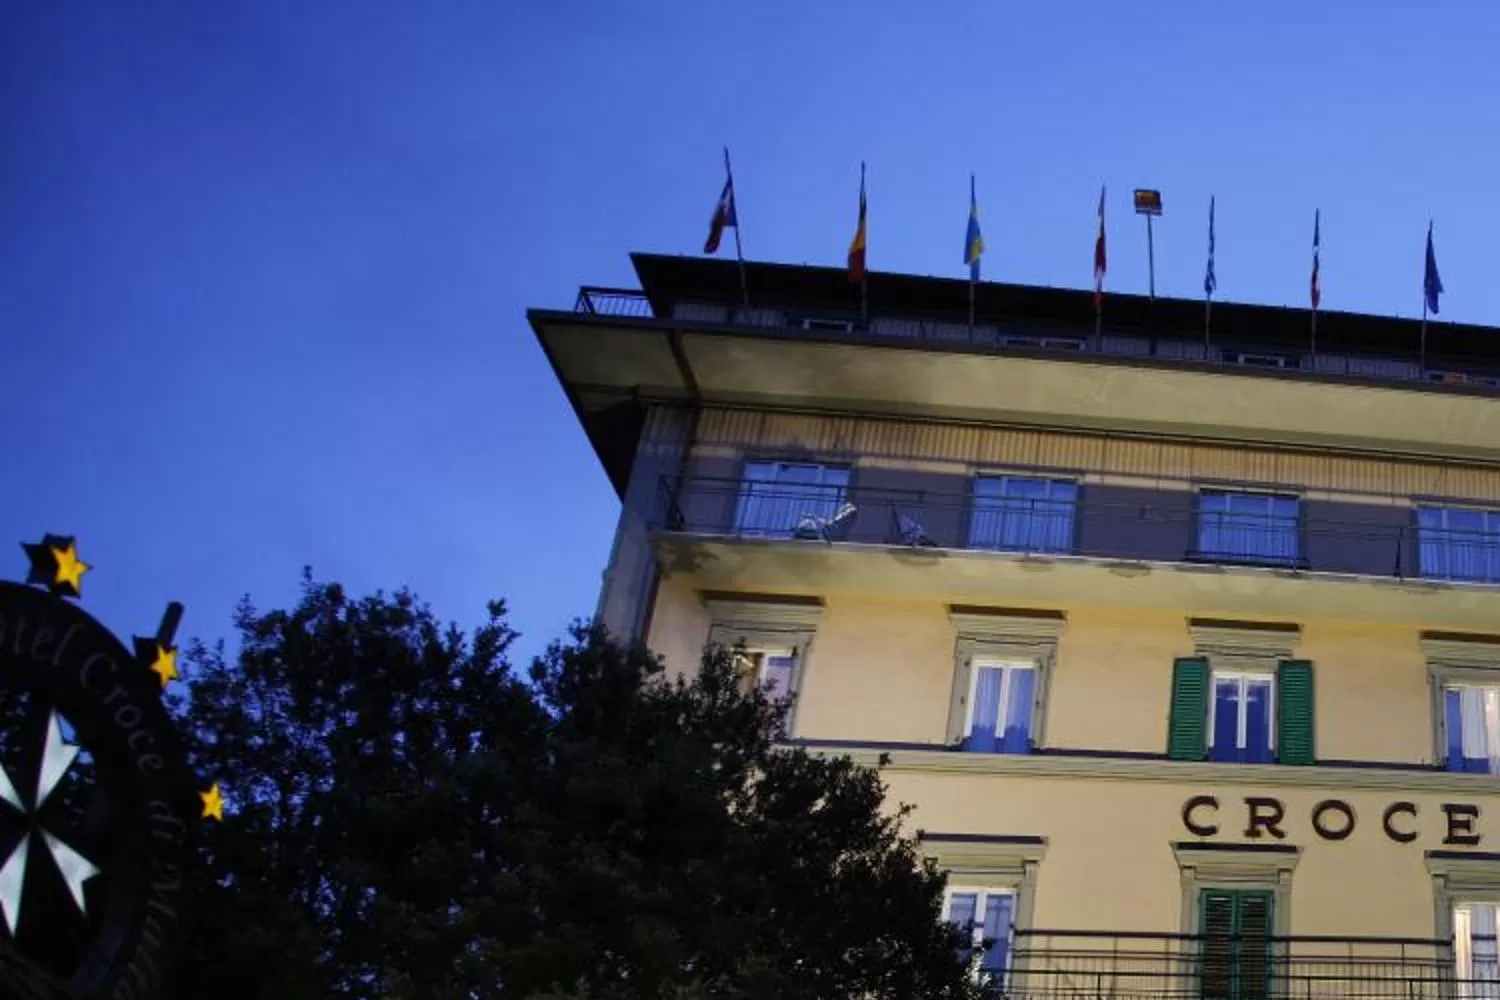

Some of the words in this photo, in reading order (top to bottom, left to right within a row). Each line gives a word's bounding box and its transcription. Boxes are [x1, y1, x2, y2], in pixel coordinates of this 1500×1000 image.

[0, 612, 86, 669] tel
[80, 652, 165, 777] Croce
[1180, 794, 1481, 847] CROCE
